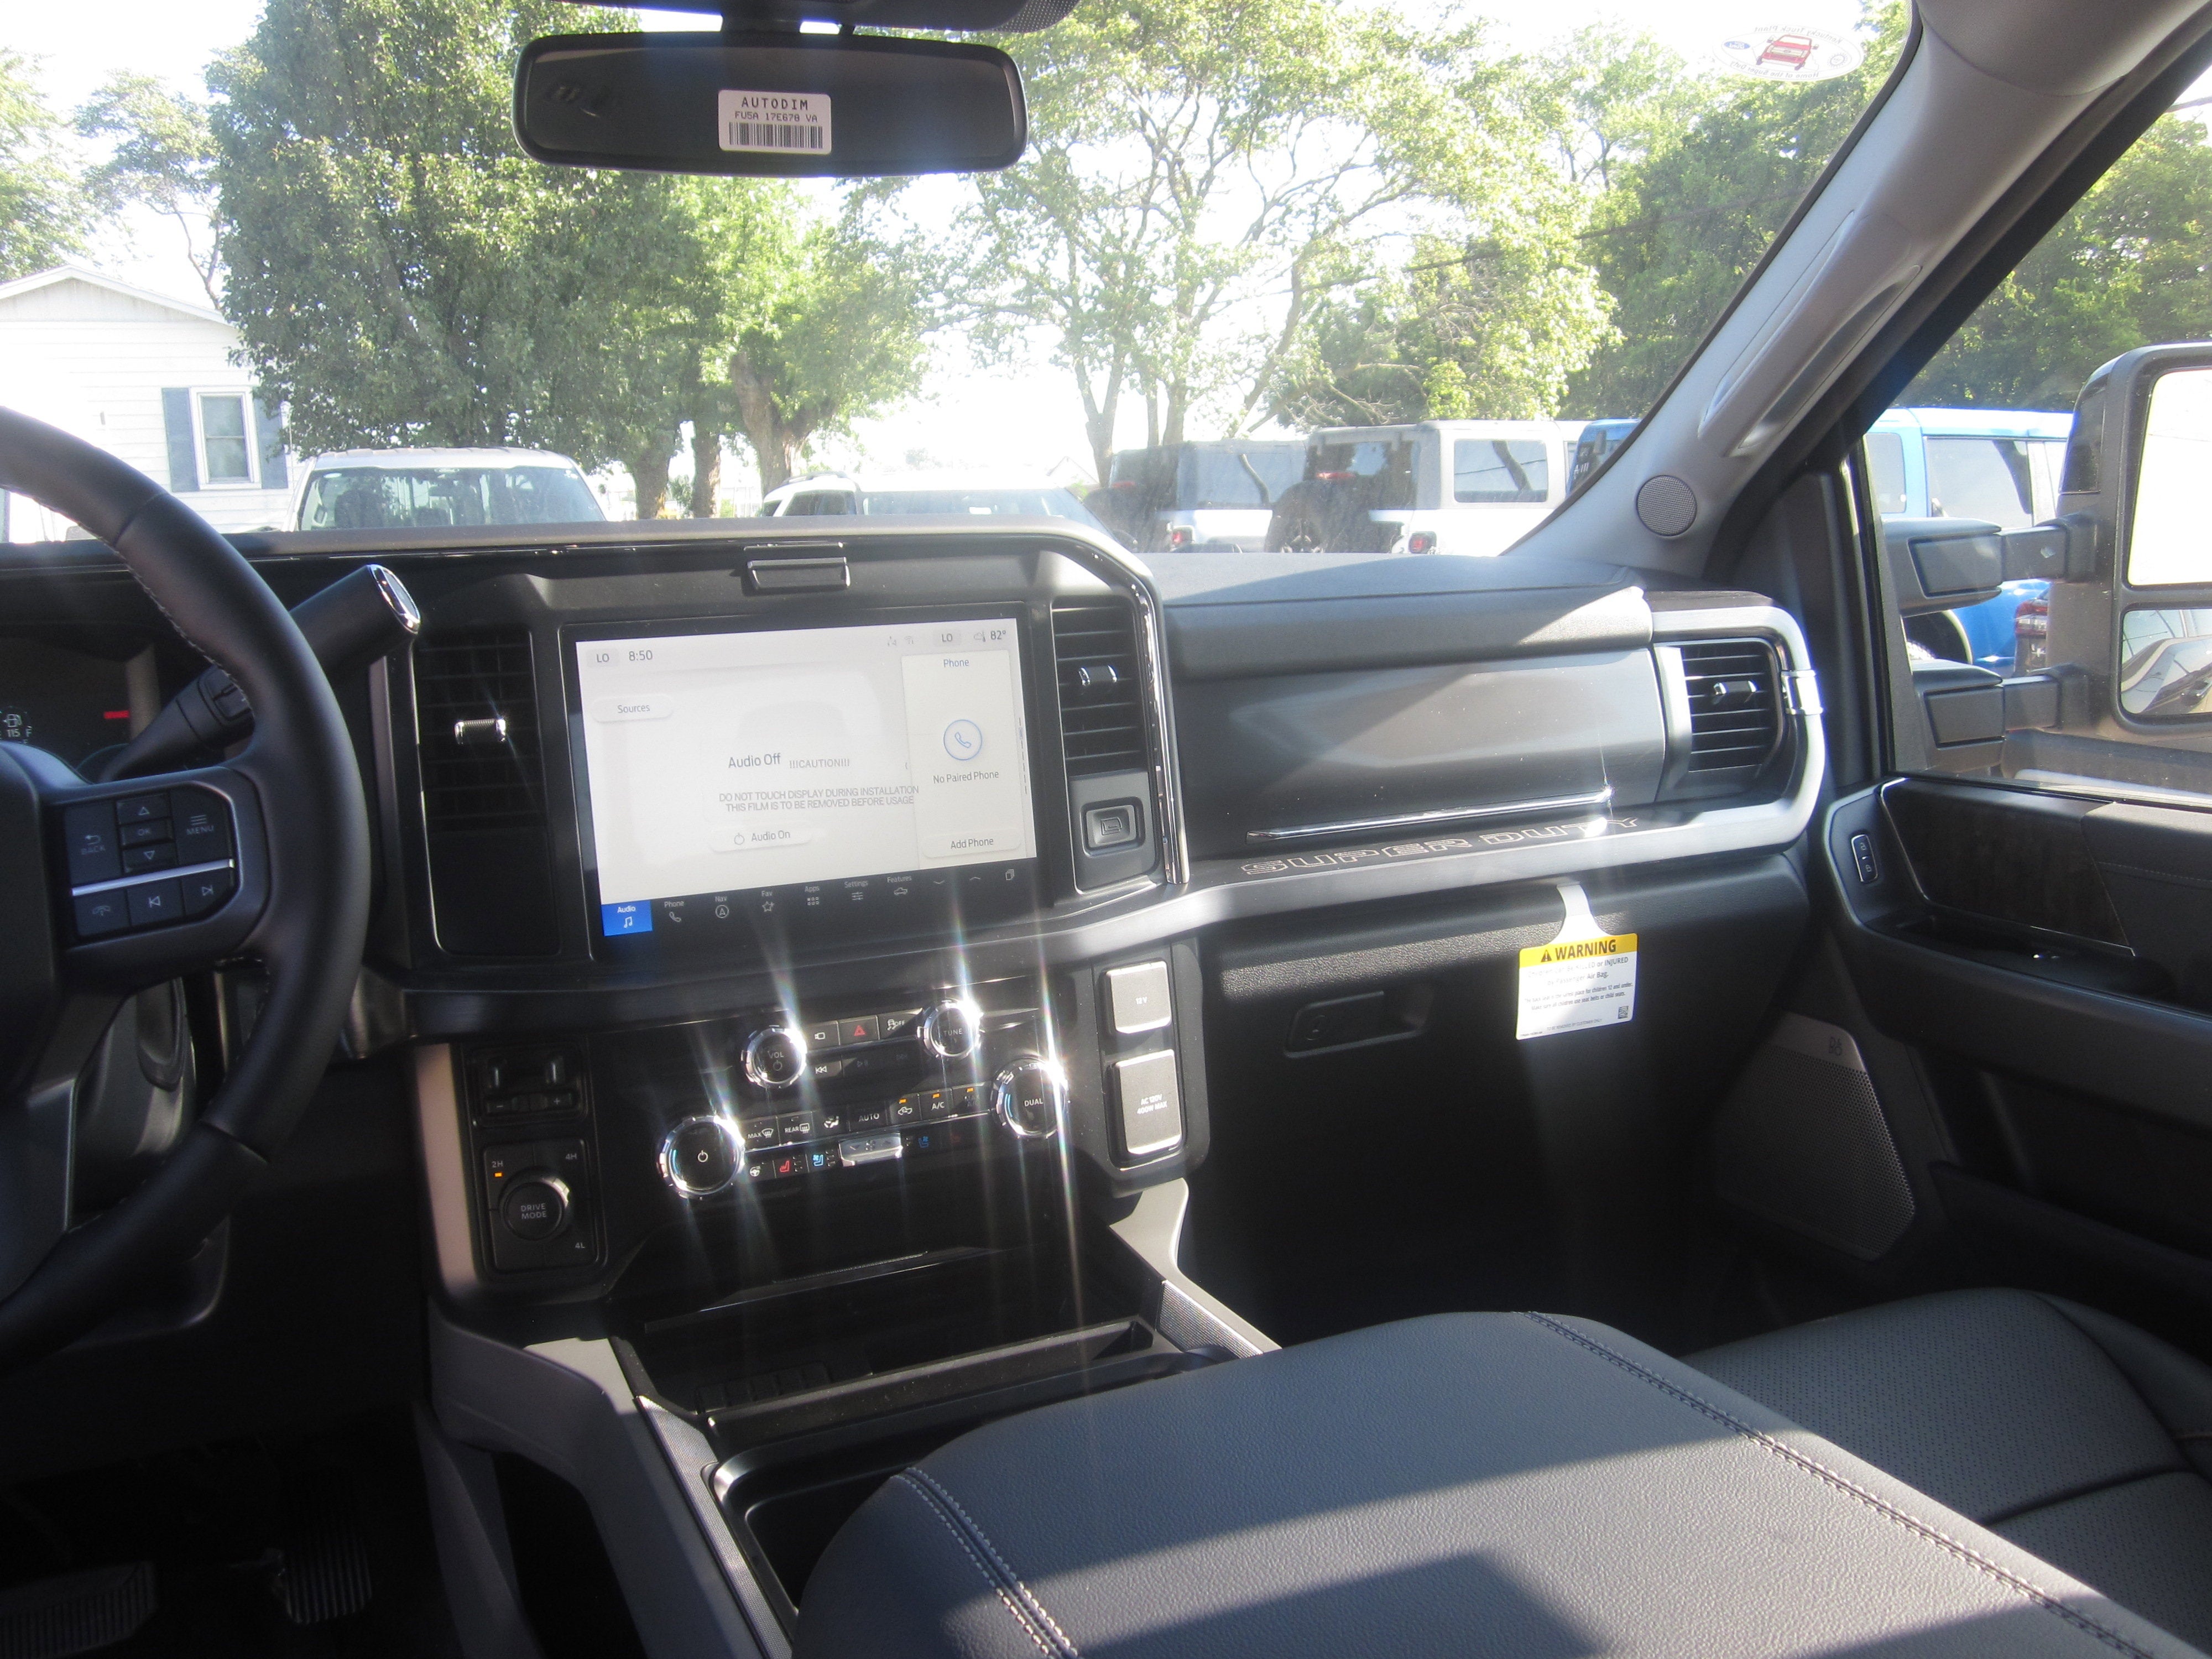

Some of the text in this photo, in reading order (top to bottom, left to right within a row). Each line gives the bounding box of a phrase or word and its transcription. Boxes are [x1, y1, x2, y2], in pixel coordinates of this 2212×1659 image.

[742, 97, 808, 110] AUTODIM
[765, 113, 800, 122] 17E678
[806, 114, 817, 122] VA
[942, 633, 953, 643] LO
[990, 630, 1006, 640] 82°
[596, 653, 609, 662] LO
[628, 650, 653, 661] 8:50
[943, 659, 969, 668] Phone
[617, 703, 650, 714] Sources
[728, 753, 781, 769] Audio Off
[933, 770, 999, 784] No Paired Phone
[719, 786, 919, 802] DO NOT TOUCH DISPLAY DURING INSTALLATION
[726, 796, 914, 812] THIS FILM IS TO BE REMOVED BEFORE USAGE
[138, 828, 152, 836] OK
[186, 825, 215, 836] MENU
[751, 830, 790, 842] Audio On
[951, 837, 994, 849] Add Phone
[1240, 816, 1639, 875] SUPER DUTY
[81, 845, 106, 855] BACK
[844, 879, 868, 888] Settings
[887, 875, 912, 884] Features
[617, 905, 636, 913] Audio
[664, 900, 684, 909] Phone
[1555, 939, 1616, 961] WARNING
[1605, 957, 1628, 966] INJURED
[931, 1101, 945, 1110] A/C
[1024, 1098, 1044, 1107] DUAL
[859, 1113, 879, 1122] AUTO
